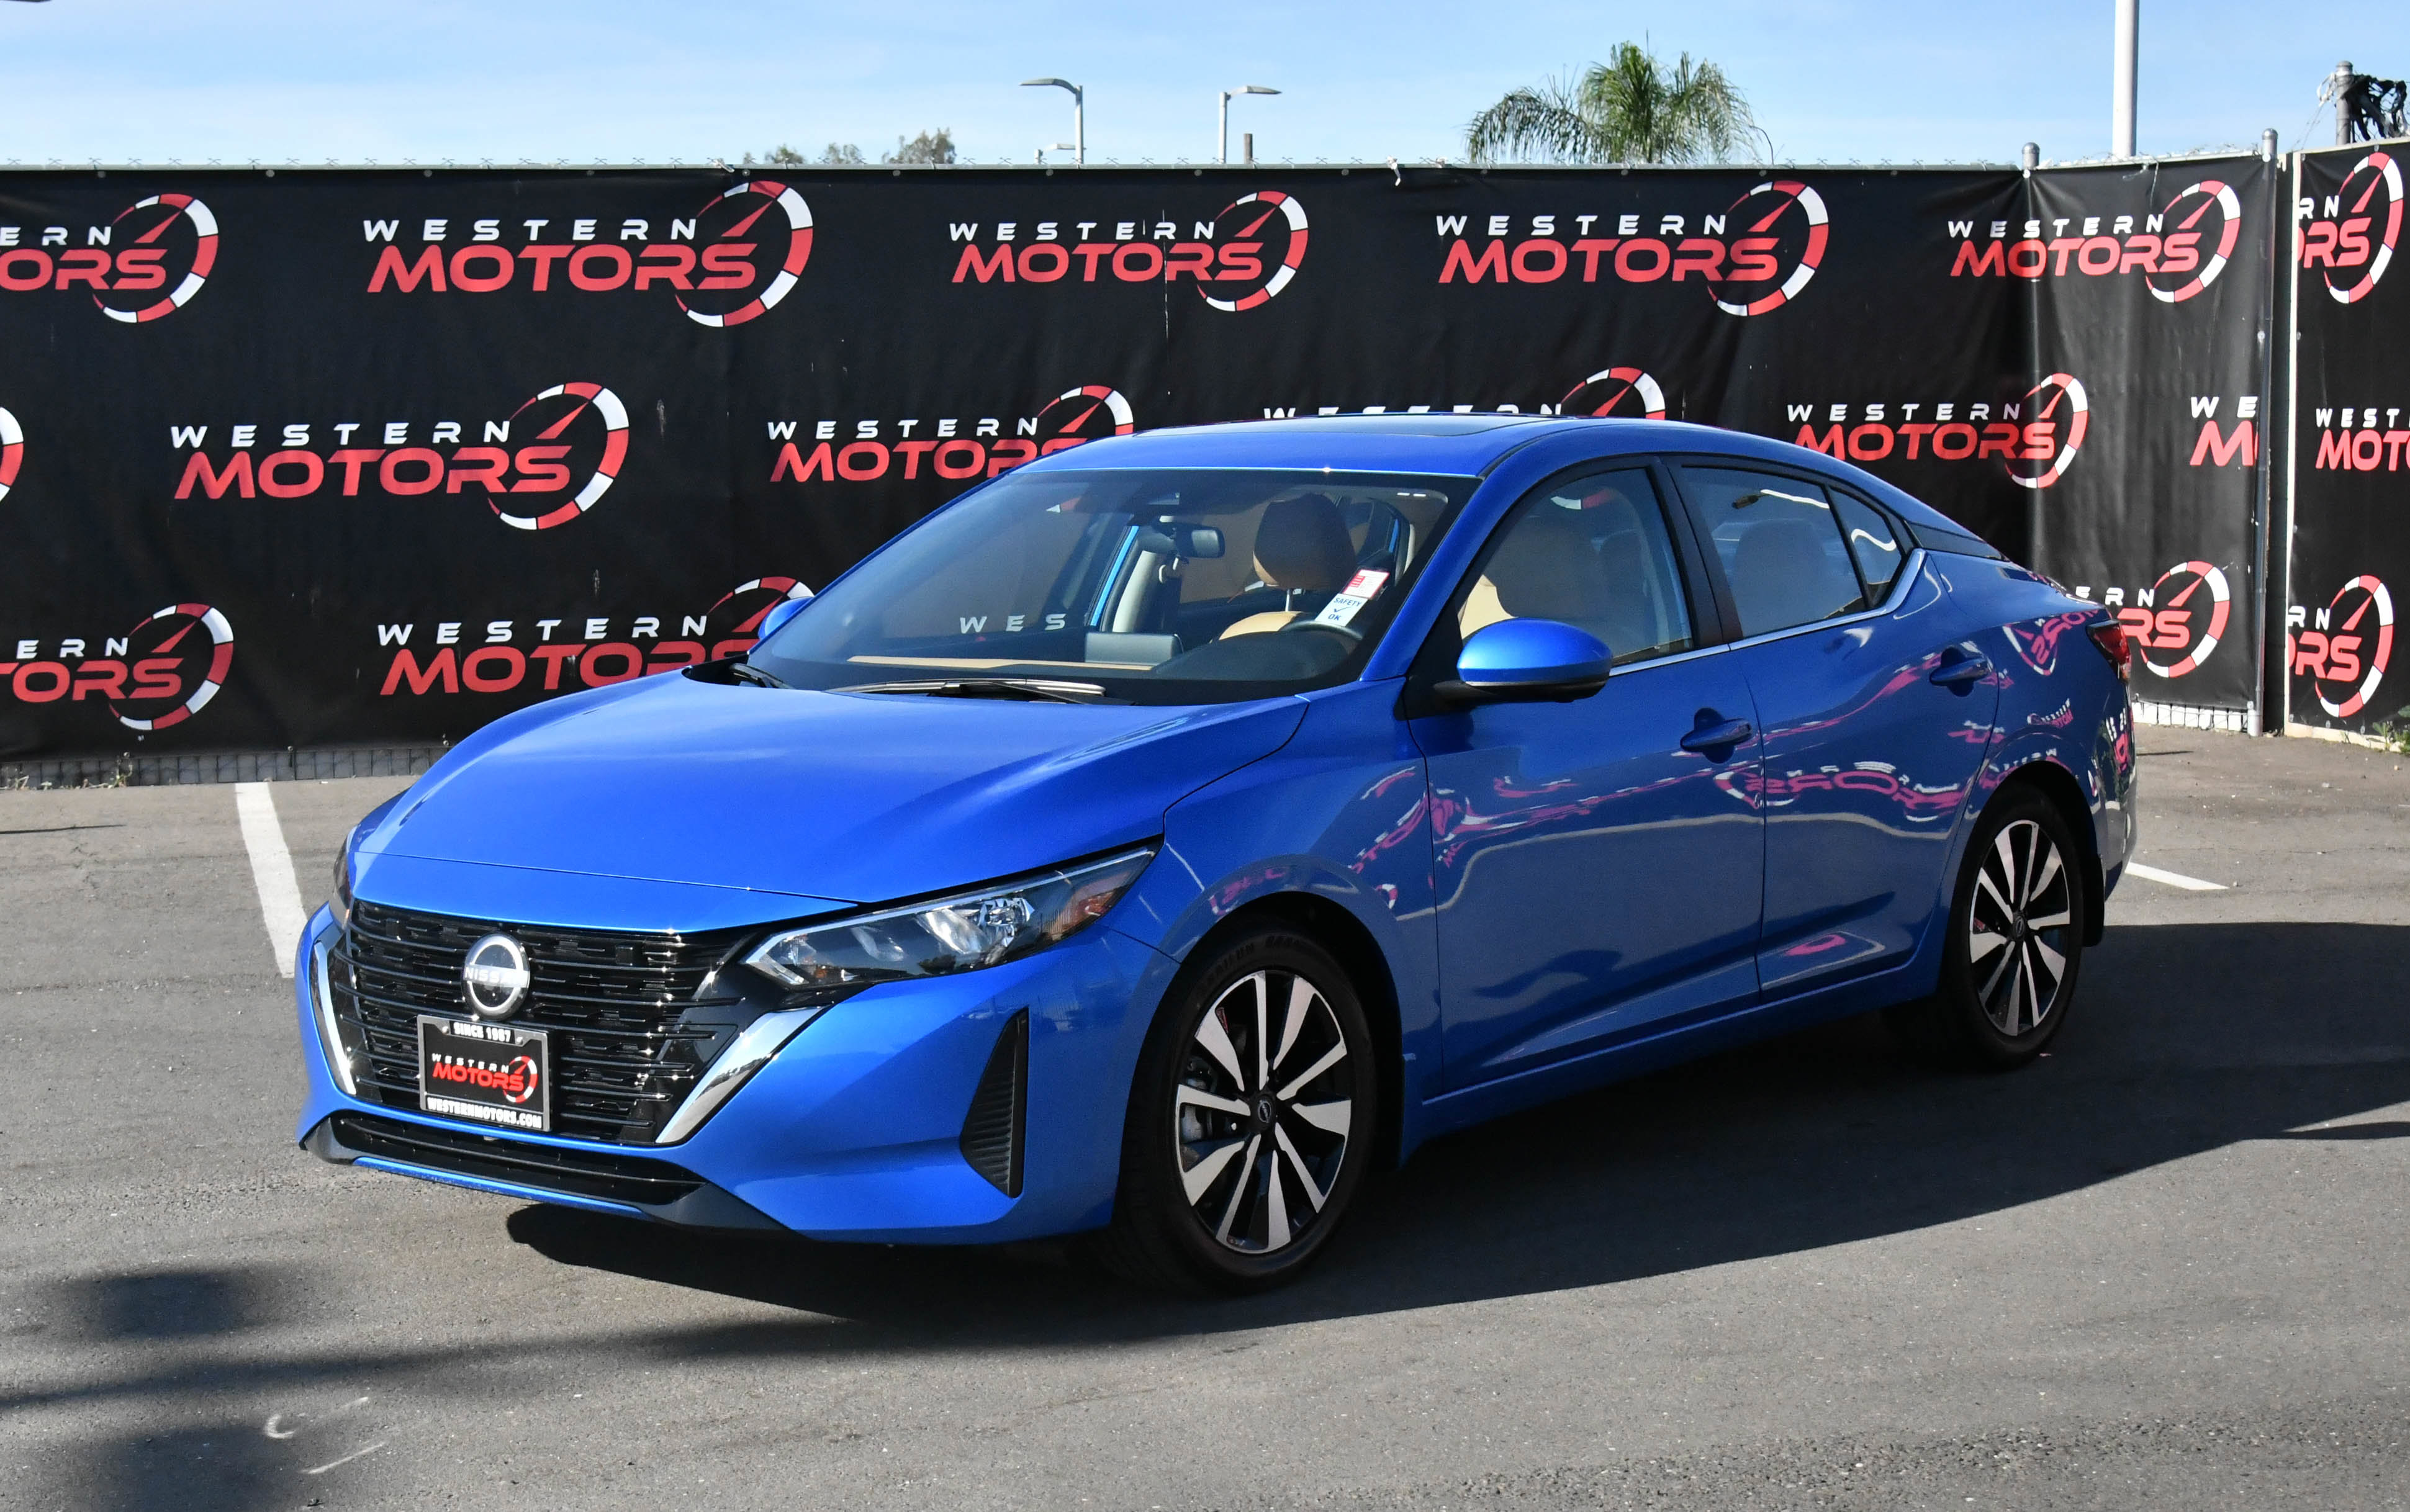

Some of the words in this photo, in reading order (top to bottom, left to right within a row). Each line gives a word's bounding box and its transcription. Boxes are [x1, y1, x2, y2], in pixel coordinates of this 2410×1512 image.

[0, 226, 111, 246] ERN
[363, 219, 697, 242] WESTERN
[950, 222, 1214, 241] WESTERN
[1436, 215, 1726, 236] WESTERN
[1947, 214, 2164, 238] WESTERN
[1951, 232, 2202, 277] MOTORS
[2298, 217, 2372, 268] RS
[0, 249, 168, 291] ORS
[368, 243, 757, 293] MOTORS
[952, 243, 1263, 283] MOTORS
[1438, 238, 1779, 284] MOTORS
[1787, 403, 2020, 422] WESTERN
[2190, 396, 2259, 419] WE
[2316, 408, 2410, 428] WEST
[171, 421, 510, 448] WESTERN
[767, 418, 1038, 440] WESTERN
[1795, 423, 2056, 461] MOTORS
[2190, 420, 2259, 467] M
[2315, 429, 2410, 472] MOT
[174, 446, 572, 499] MOTORS
[1334, 597, 1362, 607] SAFETY
[377, 616, 707, 646] WESTERN
[959, 613, 1089, 634] WES
[16, 638, 129, 659] ERN
[2288, 631, 2363, 682] RS
[0, 659, 184, 703] ORS
[464, 966, 527, 986] NISS
[453, 1022, 484, 1038] SINCE
[486, 1027, 511, 1042] 1987
[431, 1053, 509, 1074] WESTERN
[433, 1062, 524, 1092] MOTORS
[427, 1097, 542, 1128] WESTERNMOTORS.COM
